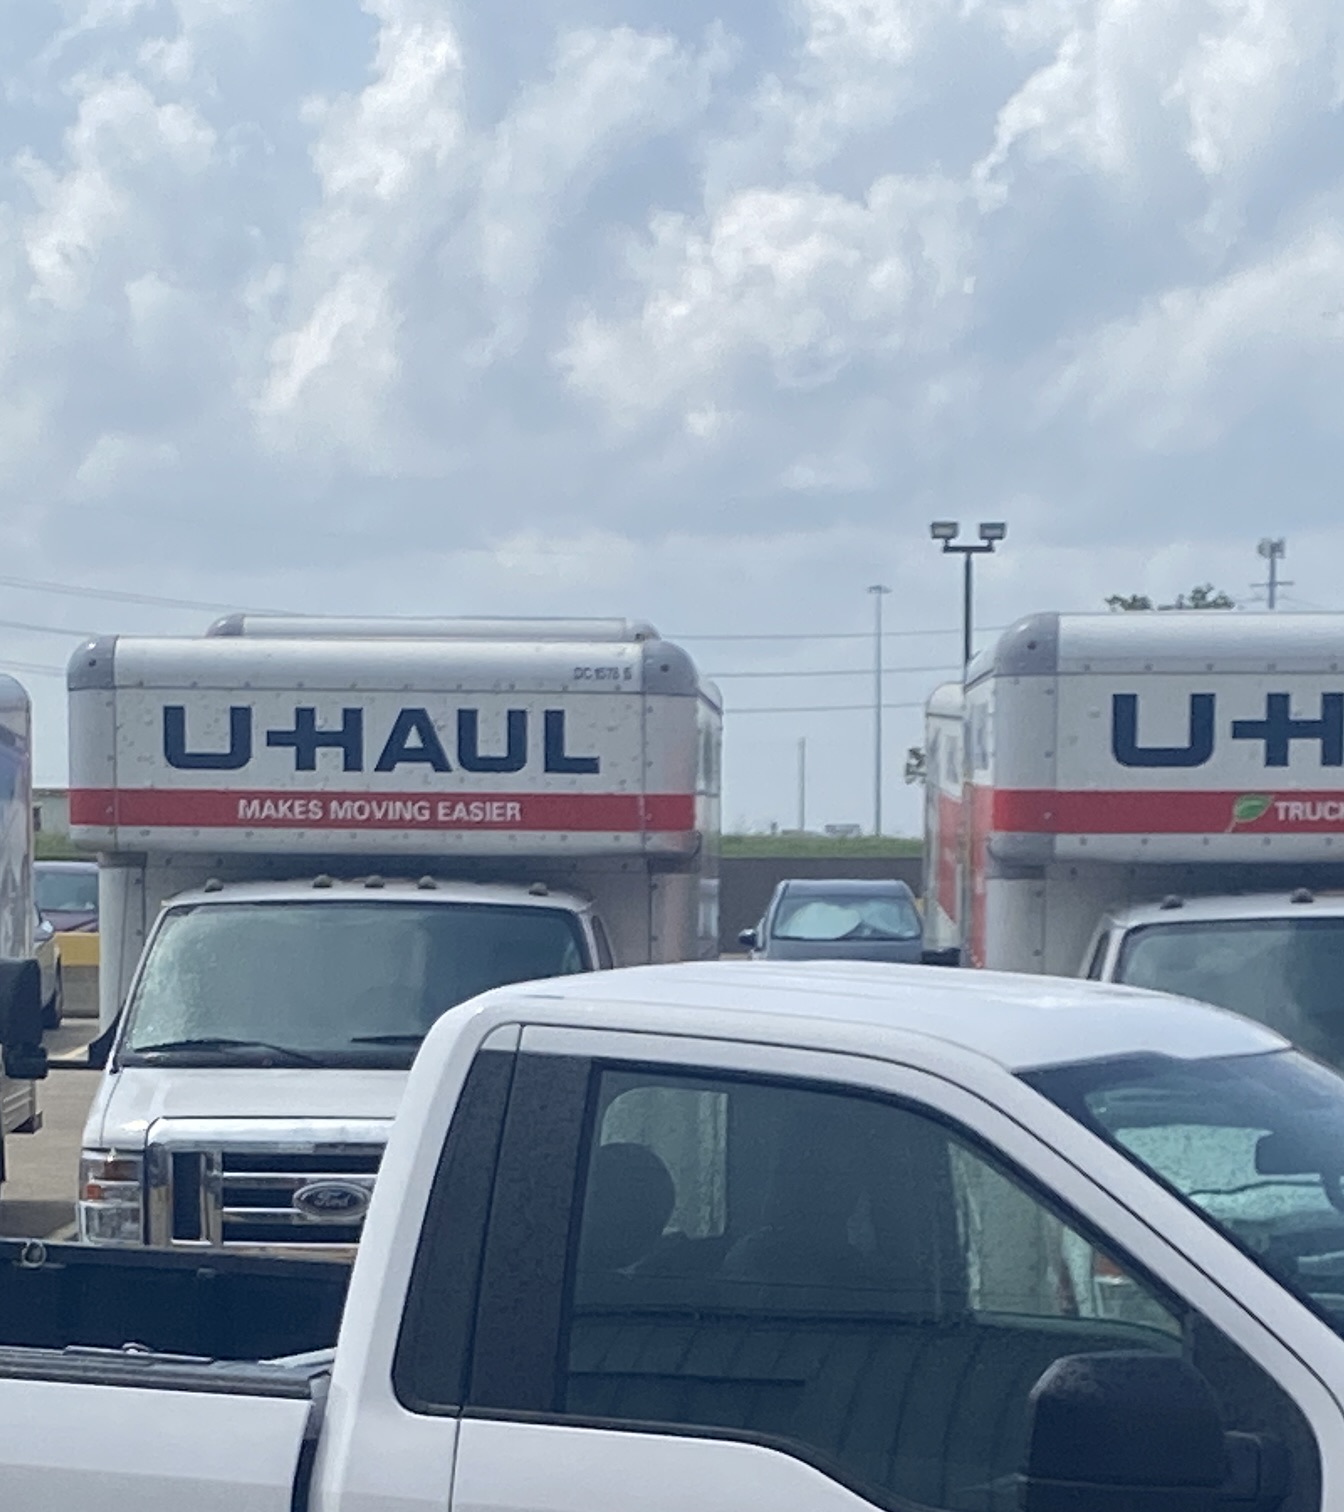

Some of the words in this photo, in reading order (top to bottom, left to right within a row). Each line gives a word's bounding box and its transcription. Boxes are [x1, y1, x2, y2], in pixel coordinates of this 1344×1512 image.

[163, 705, 601, 774] U-HAUL
[237, 798, 322, 820] MAKES
[330, 800, 430, 822] MOVING
[437, 801, 521, 822] EASIER
